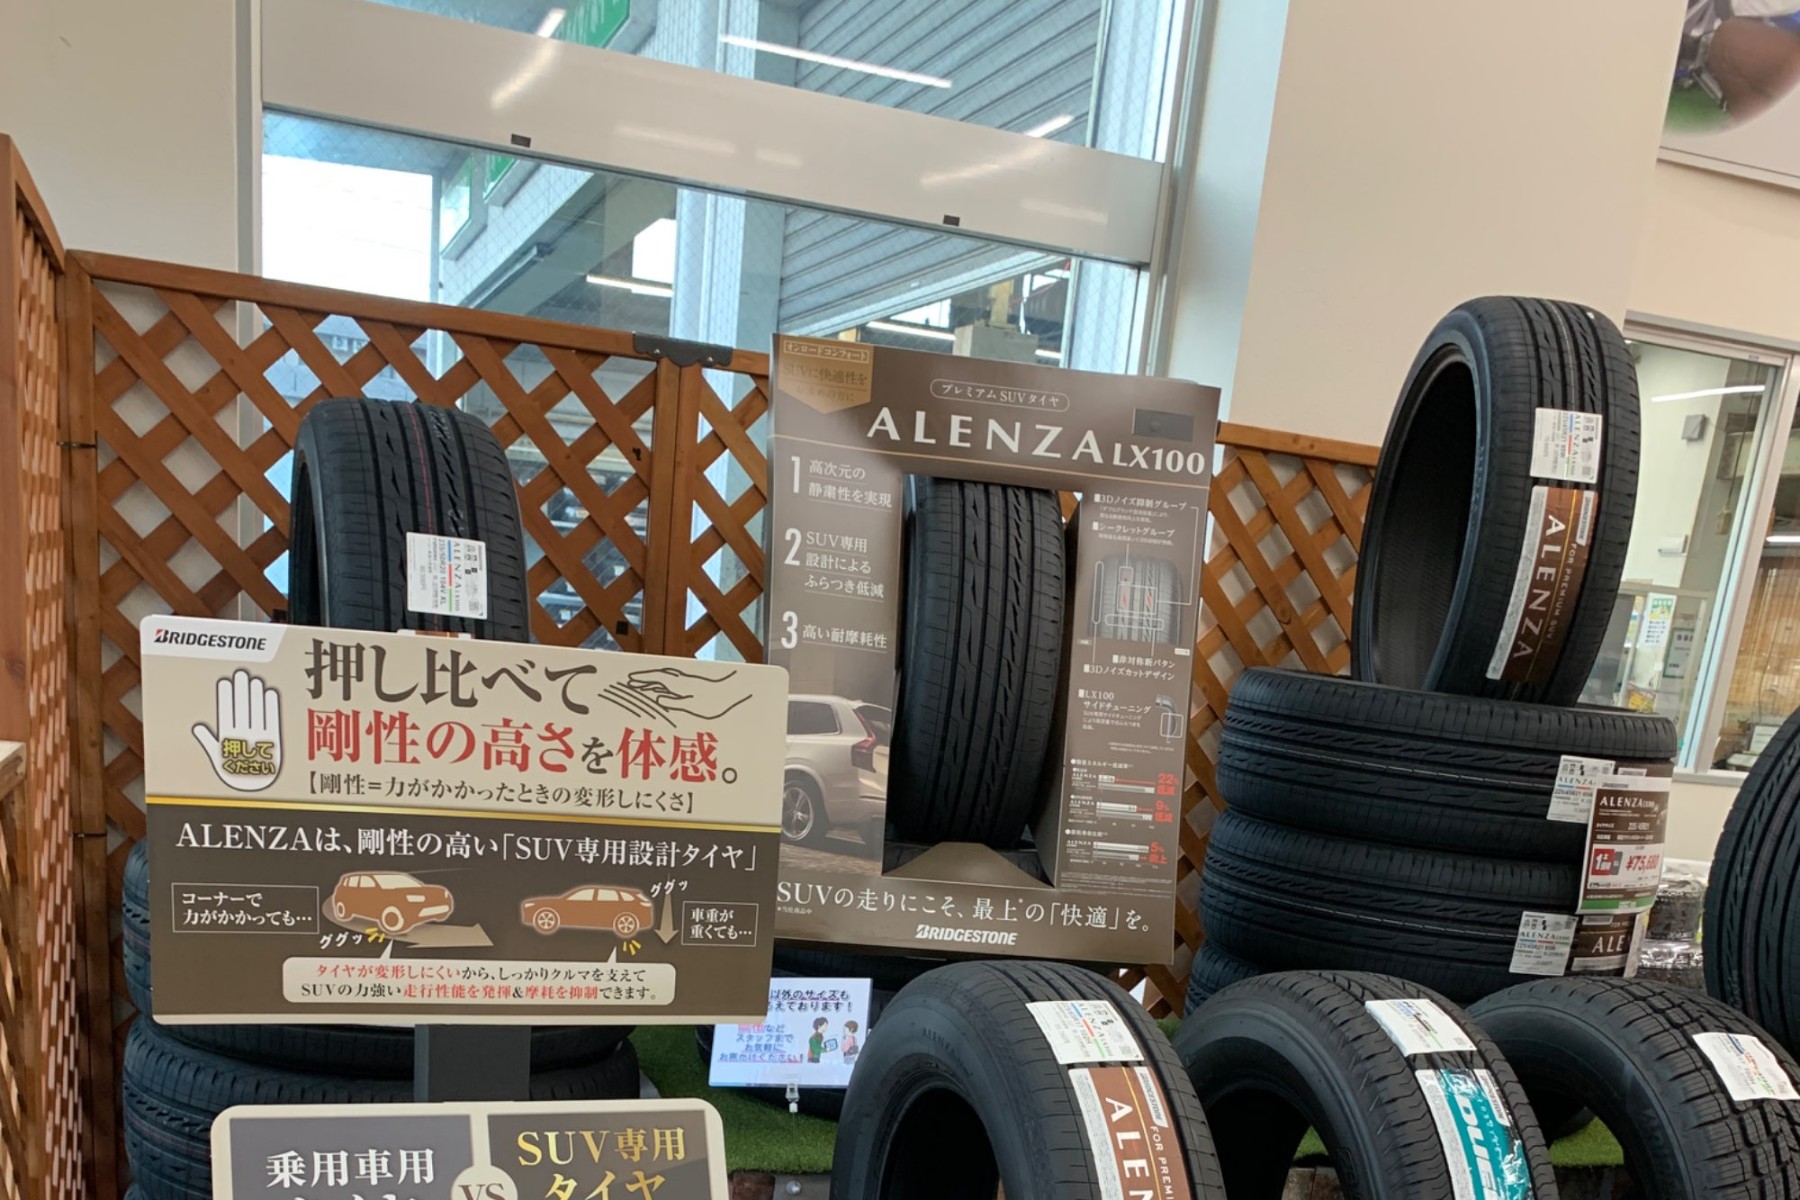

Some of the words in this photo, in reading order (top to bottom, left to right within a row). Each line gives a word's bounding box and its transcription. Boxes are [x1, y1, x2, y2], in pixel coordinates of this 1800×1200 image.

[867, 405, 1104, 464] ALENZA
[1112, 447, 1206, 476] LX100
[790, 455, 801, 494] 1
[809, 458, 866, 481] 高次元の
[808, 481, 893, 508] 静粛性を実現
[784, 527, 801, 567] 2
[806, 530, 869, 554] SUV専用
[805, 551, 872, 575] 設計による
[804, 574, 885, 599] ふらつき低減
[1512, 513, 1567, 660] ALENZA
[153, 627, 267, 653] BRIDGESTONE
[780, 610, 799, 650] 3
[802, 623, 888, 650] 高い耐摩耗性
[304, 636, 600, 717] 押し比べて
[1083, 700, 1152, 714] サイドチューニング
[1085, 690, 1115, 701] LX100
[222, 738, 275, 760] 押して
[305, 707, 740, 786] 剛性の高さを体感。
[222, 757, 276, 777] ください
[1599, 796, 1643, 808] ALENZA
[181, 890, 264, 909] コーナーで
[690, 907, 735, 924] 車重が
[914, 923, 1019, 946] BRIDGESTONE
[1591, 934, 1627, 954] ALE
[516, 1126, 687, 1168] SUV専用
[1151, 1125, 1164, 1152] FOR
[265, 1148, 436, 1190] 乗用車用
